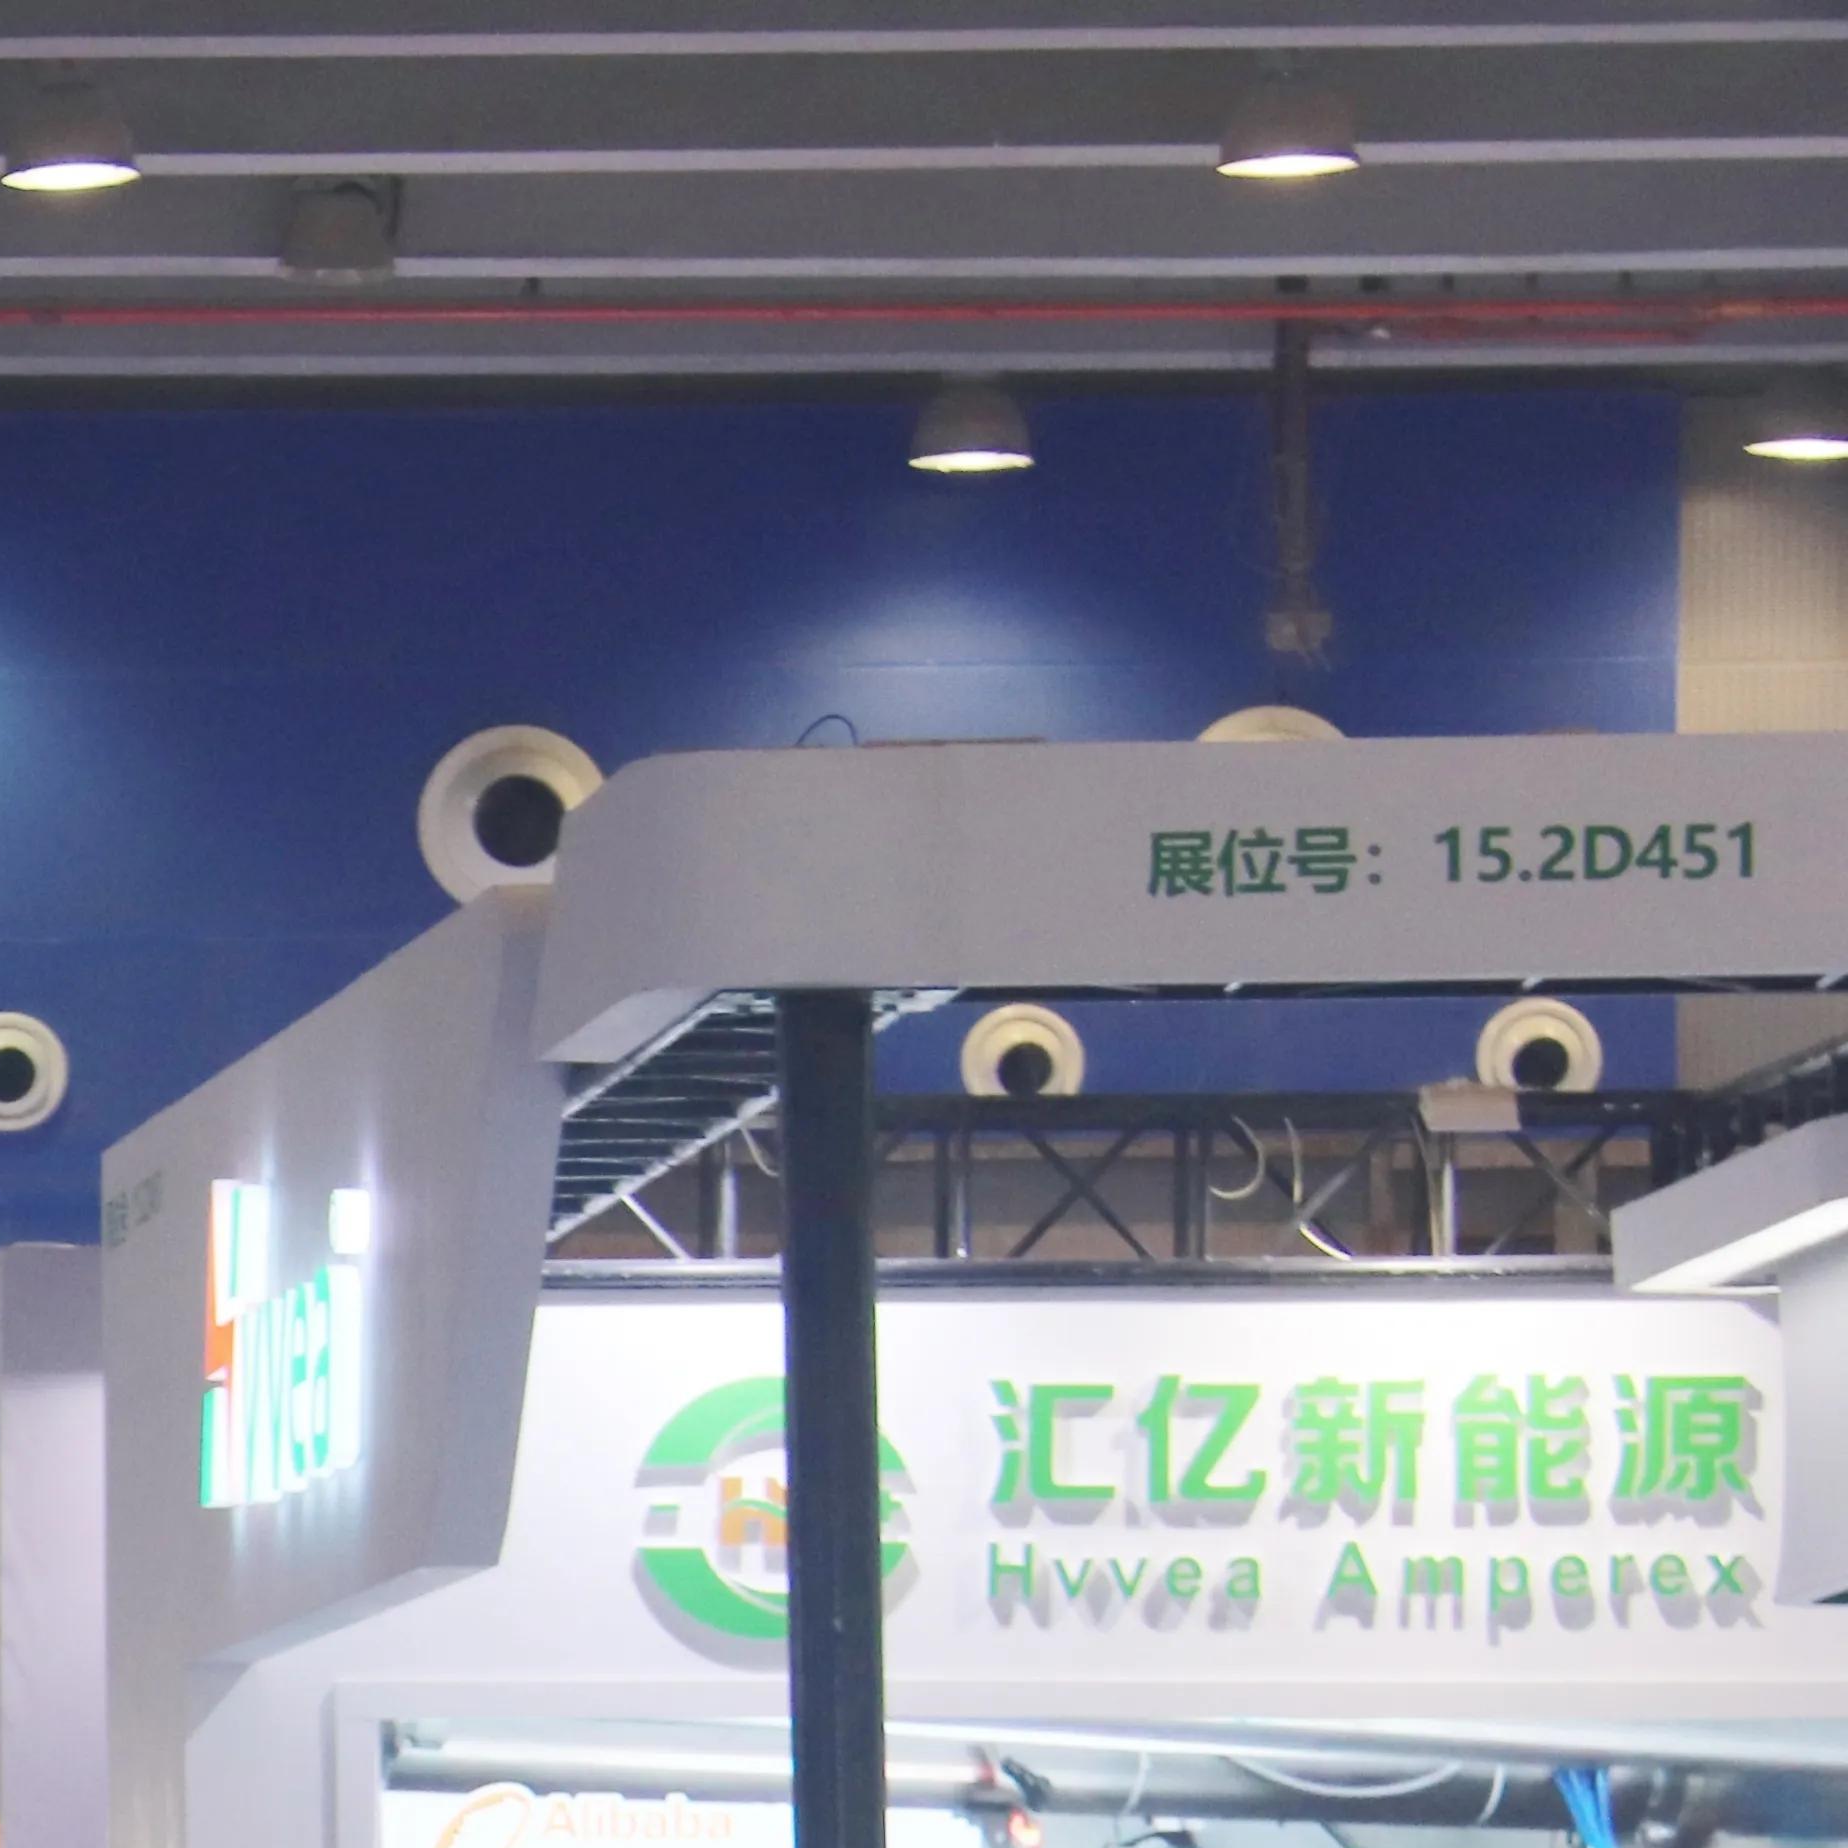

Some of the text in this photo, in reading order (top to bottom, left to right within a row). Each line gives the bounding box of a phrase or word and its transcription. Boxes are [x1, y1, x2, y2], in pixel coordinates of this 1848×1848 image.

[1434, 822, 1758, 884] 15.2D451
[992, 1371, 1753, 1506] 汇亿新能源
[1328, 1539, 1748, 1615] Amperex
[543, 1793, 735, 1842] Alibaba
